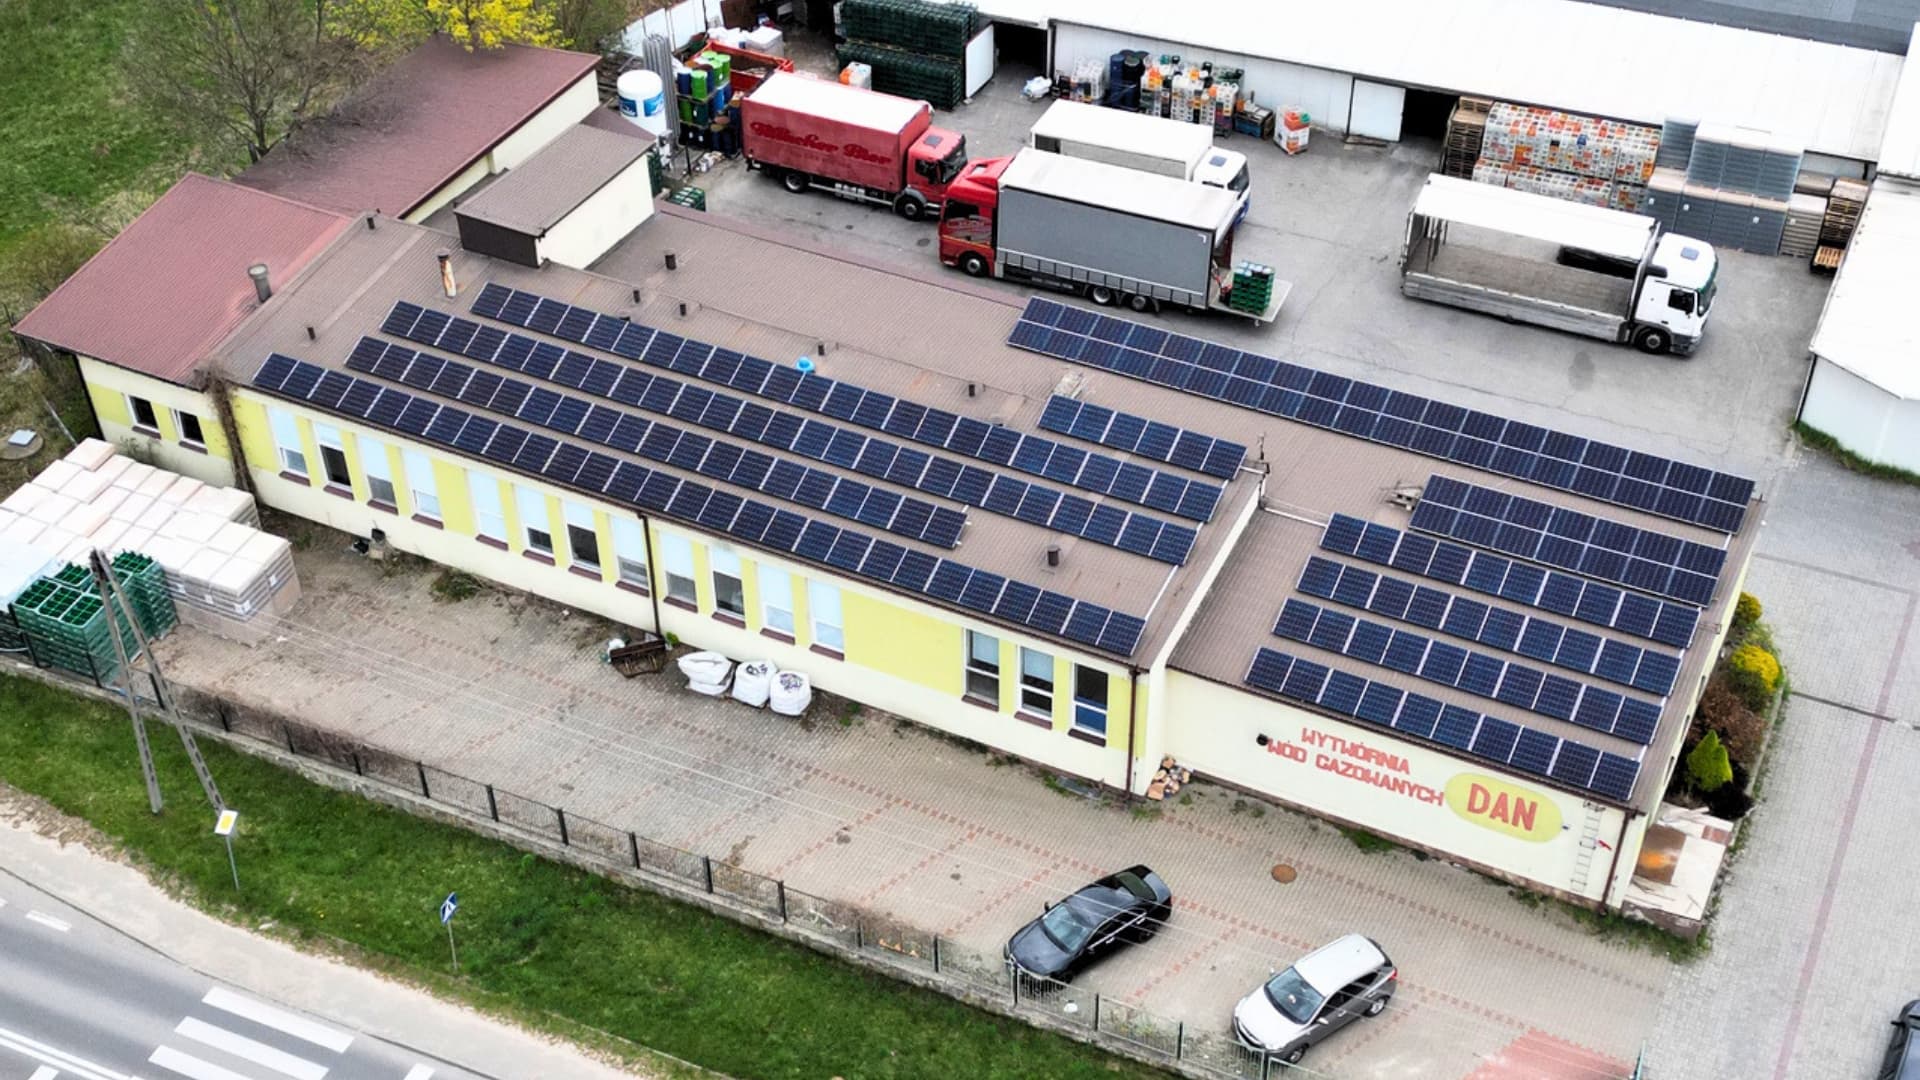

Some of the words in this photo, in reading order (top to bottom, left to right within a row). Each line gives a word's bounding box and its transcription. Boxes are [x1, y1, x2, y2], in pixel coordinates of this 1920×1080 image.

[1266, 738, 1308, 763] WÓD
[1315, 753, 1444, 806] GAZOWANYCH
[1301, 727, 1410, 775] WYTWÓRNIA
[1466, 782, 1538, 832] DAN
